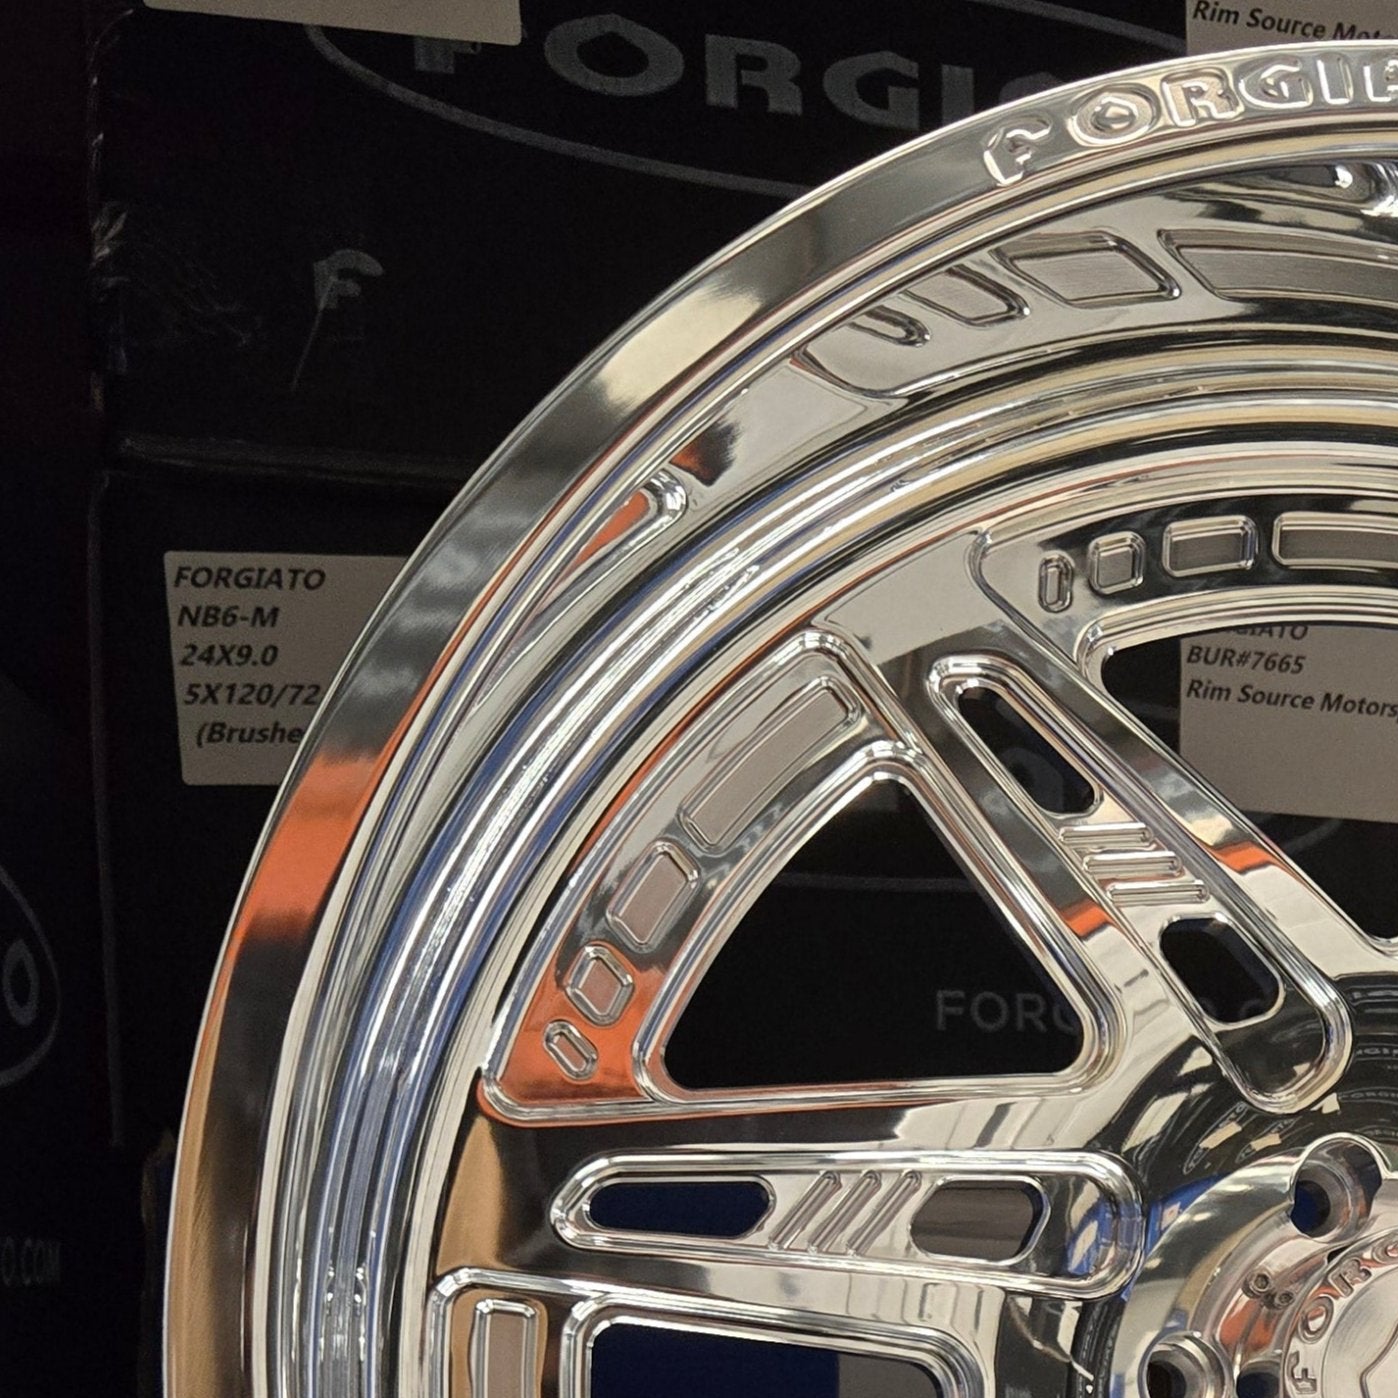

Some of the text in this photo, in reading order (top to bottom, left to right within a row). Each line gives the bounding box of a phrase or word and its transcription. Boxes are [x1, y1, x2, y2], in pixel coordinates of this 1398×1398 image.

[1192, 0, 1397, 39] Rim Source Mo
[413, 12, 1066, 130] ORGI
[173, 566, 326, 591] FORGIATO
[177, 605, 279, 628] NB6-M
[180, 644, 279, 667] 24X9.0
[1186, 645, 1306, 674] BUR#7665
[183, 682, 321, 709] 5X120/72
[1186, 679, 1231, 702] Rim
[1237, 684, 1314, 711] Source
[196, 721, 305, 748] (Brushe
